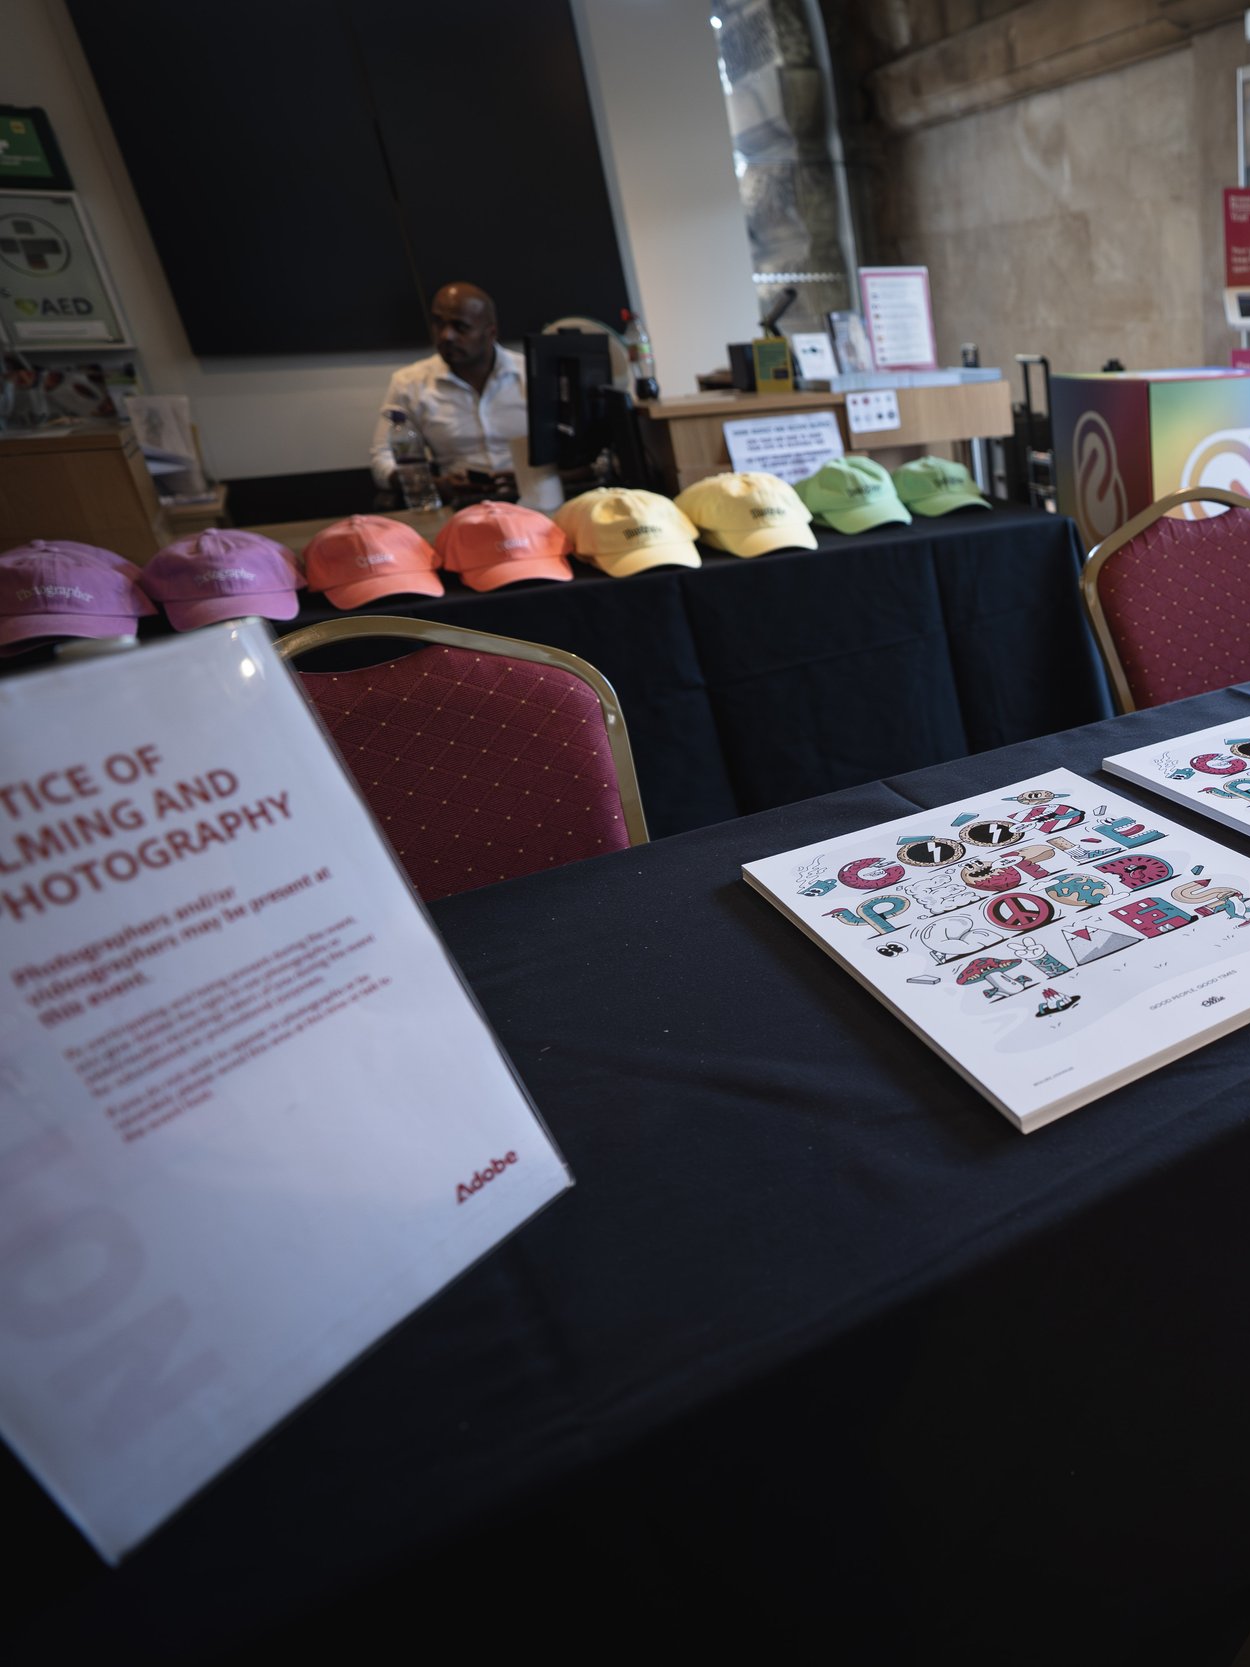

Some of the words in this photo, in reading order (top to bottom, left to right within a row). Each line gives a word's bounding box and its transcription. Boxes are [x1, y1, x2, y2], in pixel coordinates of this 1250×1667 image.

[41, 297, 93, 316] AED
[104, 744, 162, 785] OF
[152, 769, 239, 820] AND
[0, 790, 292, 922] HOTOGRAPHY
[455, 1147, 519, 1205] Adobe
